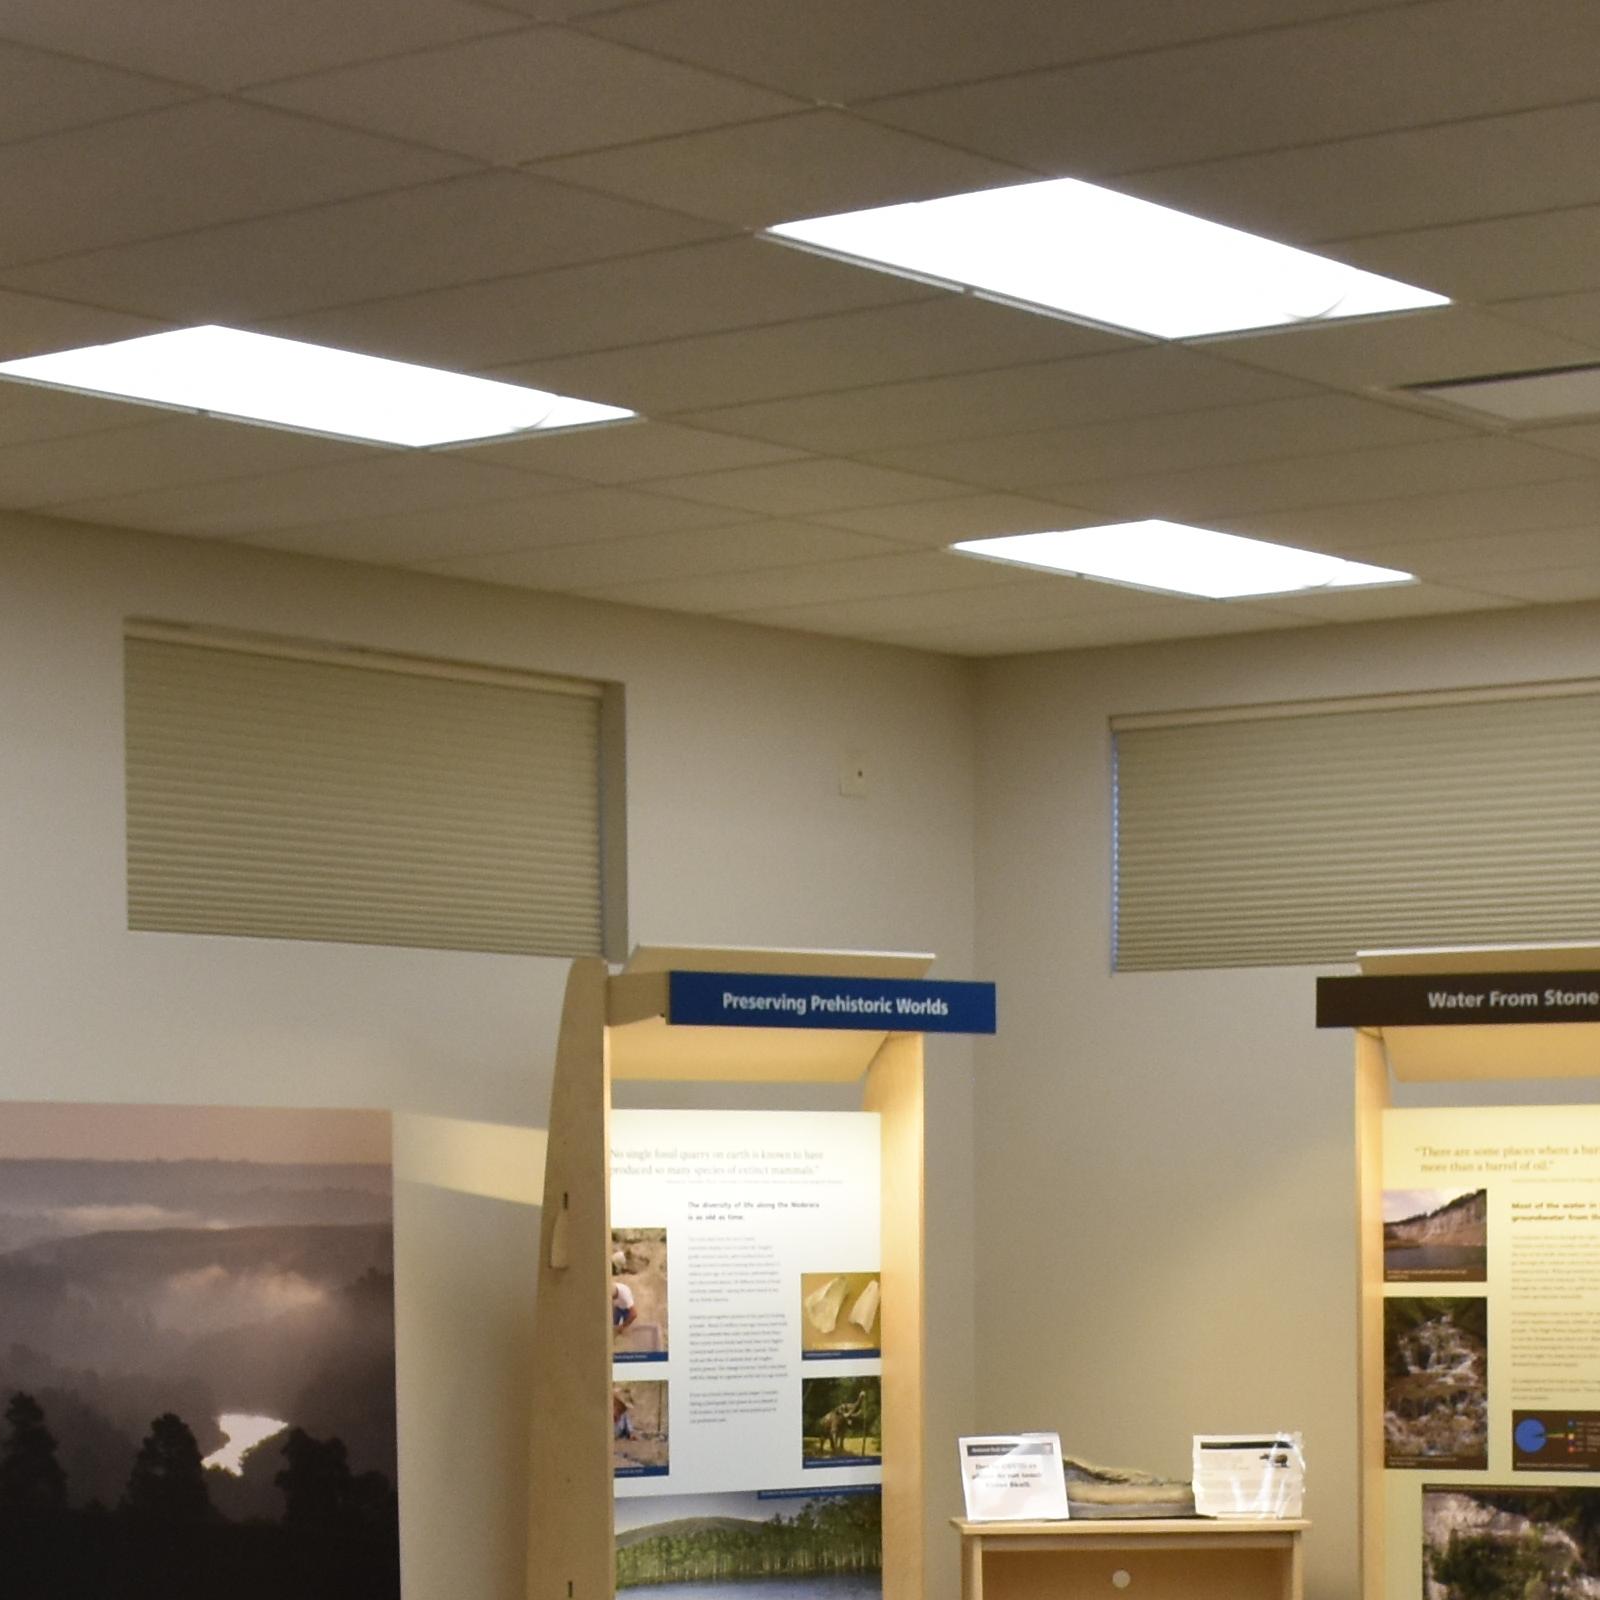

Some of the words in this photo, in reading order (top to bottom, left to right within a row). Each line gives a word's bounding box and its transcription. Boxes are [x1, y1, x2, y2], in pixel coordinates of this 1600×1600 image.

[722, 992, 807, 1016] Preserving
[811, 995, 893, 1014] Prehistoric
[896, 998, 949, 1015] Worlds
[1427, 991, 1485, 1009] Water
[1489, 991, 1539, 1007] From
[1544, 989, 1600, 1005] Stone
[1454, 1149, 1470, 1157] are
[1474, 1148, 1500, 1157] some
[1503, 1146, 1534, 1159] places
[1538, 1145, 1569, 1156] where
[1573, 1147, 1579, 1155] a
[1420, 1163, 1446, 1173] more
[1450, 1161, 1474, 1171] than
[1485, 1160, 1517, 1171] barrel
[1520, 1160, 1530, 1170] of
